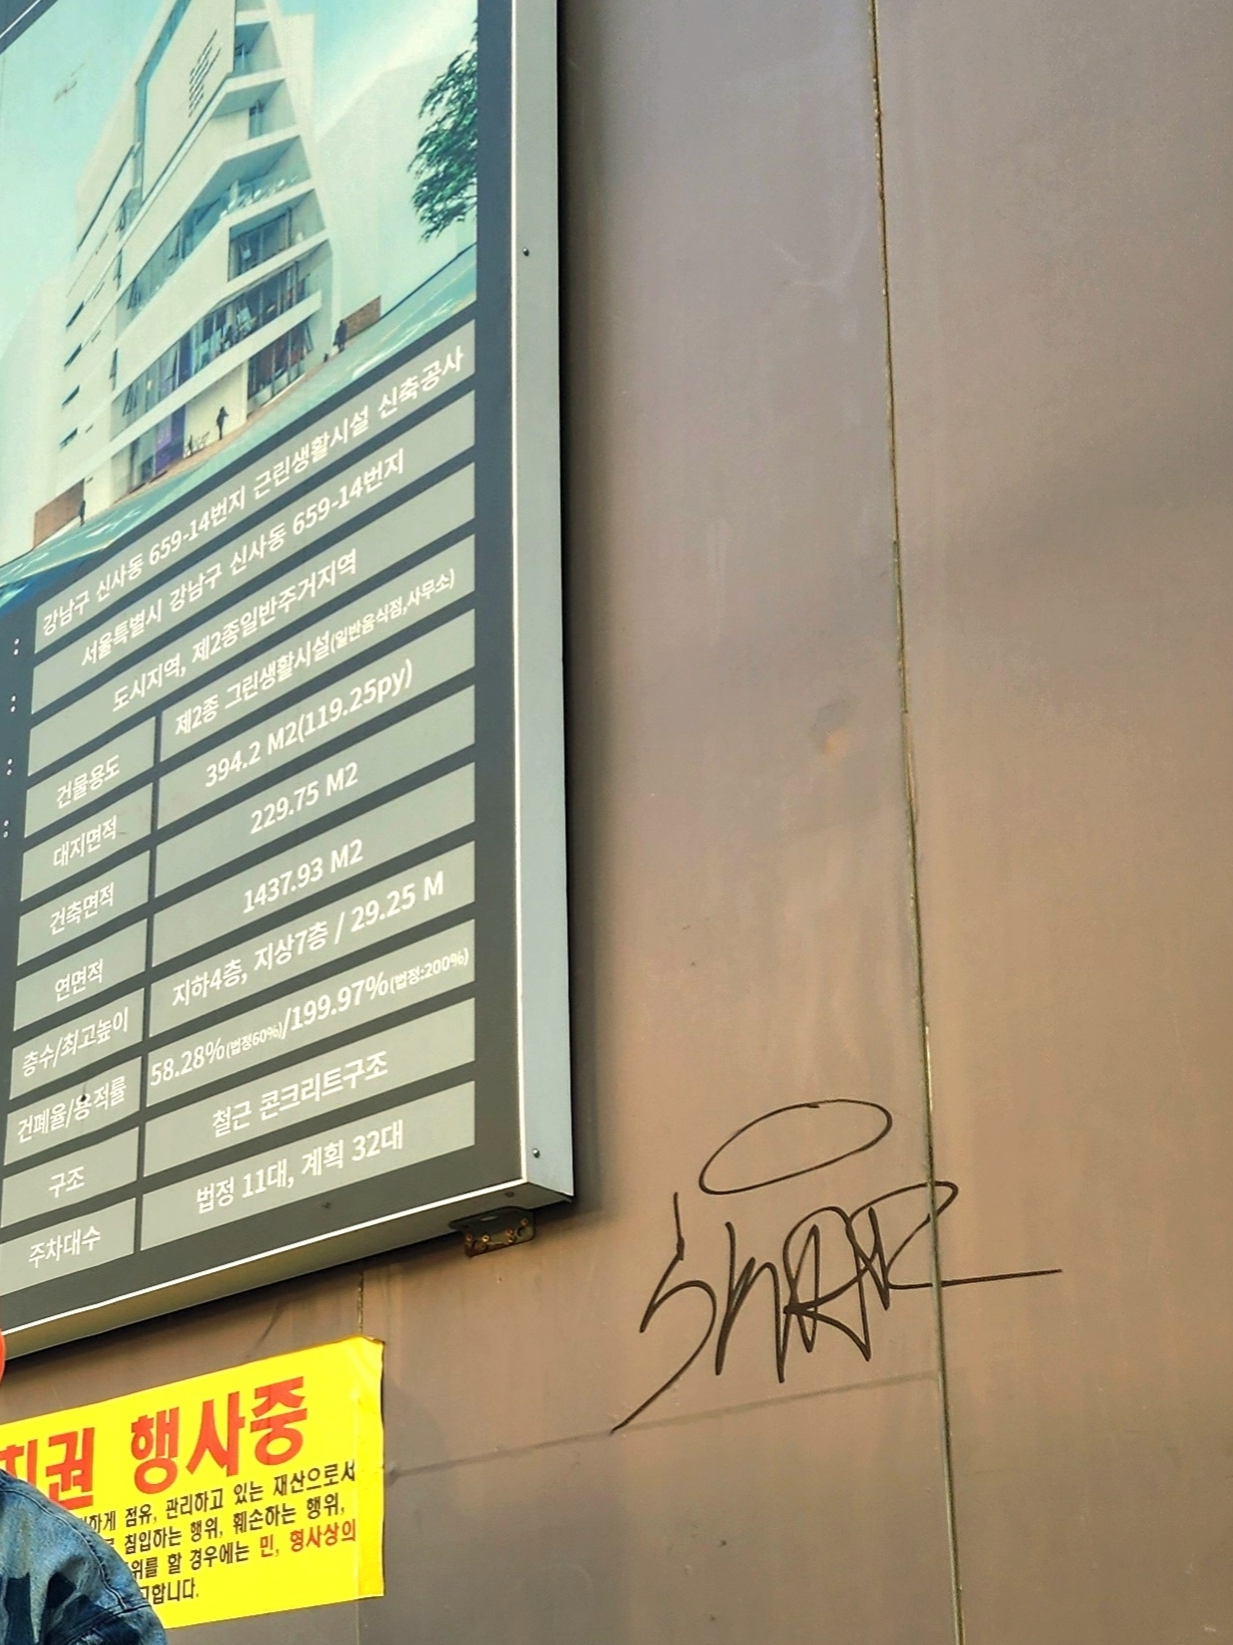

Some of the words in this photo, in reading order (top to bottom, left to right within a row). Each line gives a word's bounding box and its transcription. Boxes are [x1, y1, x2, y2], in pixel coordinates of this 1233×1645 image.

[41, 593, 91, 636] 강남구
[95, 551, 145, 602] 신사동
[149, 491, 246, 567] 659-14번지
[254, 408, 369, 499] 근린생활시설
[378, 346, 464, 420] 신축공사
[80, 604, 163, 667] 서울특별시
[169, 569, 223, 614] 강남구
[229, 527, 287, 575] 신사동
[292, 448, 406, 537] 659-14번지
[111, 660, 187, 713] 도시지역,
[192, 548, 358, 663] 제2종일반주거지역
[174, 700, 220, 735] 제2종
[205, 740, 263, 788] 394.2
[267, 660, 414, 757] M2(119.25py)
[55, 755, 121, 810] 건물용도
[250, 782, 319, 835] 229.75
[324, 761, 360, 797] M2
[52, 821, 118, 867] 대지면적
[242, 857, 324, 913] 1437.93
[329, 838, 363, 874] M2
[49, 883, 116, 935] 건축면적
[171, 959, 248, 1007] 지하4층,
[253, 920, 329, 973] 지상7층
[350, 889, 416, 933] 29.25
[422, 870, 445, 903] M
[53, 959, 104, 1003] 연면적
[21, 1005, 130, 1078] 층수/최고높이
[16, 1075, 127, 1144] 건폐율/용적률
[212, 1100, 254, 1138] 철근
[258, 1052, 389, 1122] 콘크리트구조
[48, 1165, 85, 1198] 구조
[196, 1178, 235, 1216] 법정
[241, 1157, 295, 1200] 11대,
[300, 1141, 345, 1179] 계획
[351, 1118, 404, 1163] 32대
[27, 1225, 102, 1269] 주차대수
[130, 1376, 308, 1495] 행사중
[124, 1523, 182, 1554] 침입하는
[189, 1518, 223, 1547] 행위,
[232, 1503, 295, 1534] 훼손하는
[306, 1492, 346, 1521] 행위,
[125, 1502, 158, 1529] 점유,
[165, 1487, 223, 1520] 관리하고
[233, 1481, 264, 1504] 있는
[272, 1460, 356, 1496] 재산으로서
[124, 1559, 158, 1580] 위를
[167, 1553, 183, 1575] 할
[189, 1539, 250, 1572] 경우에는
[259, 1534, 279, 1559] 민,
[289, 1519, 357, 1552] 형사상의
